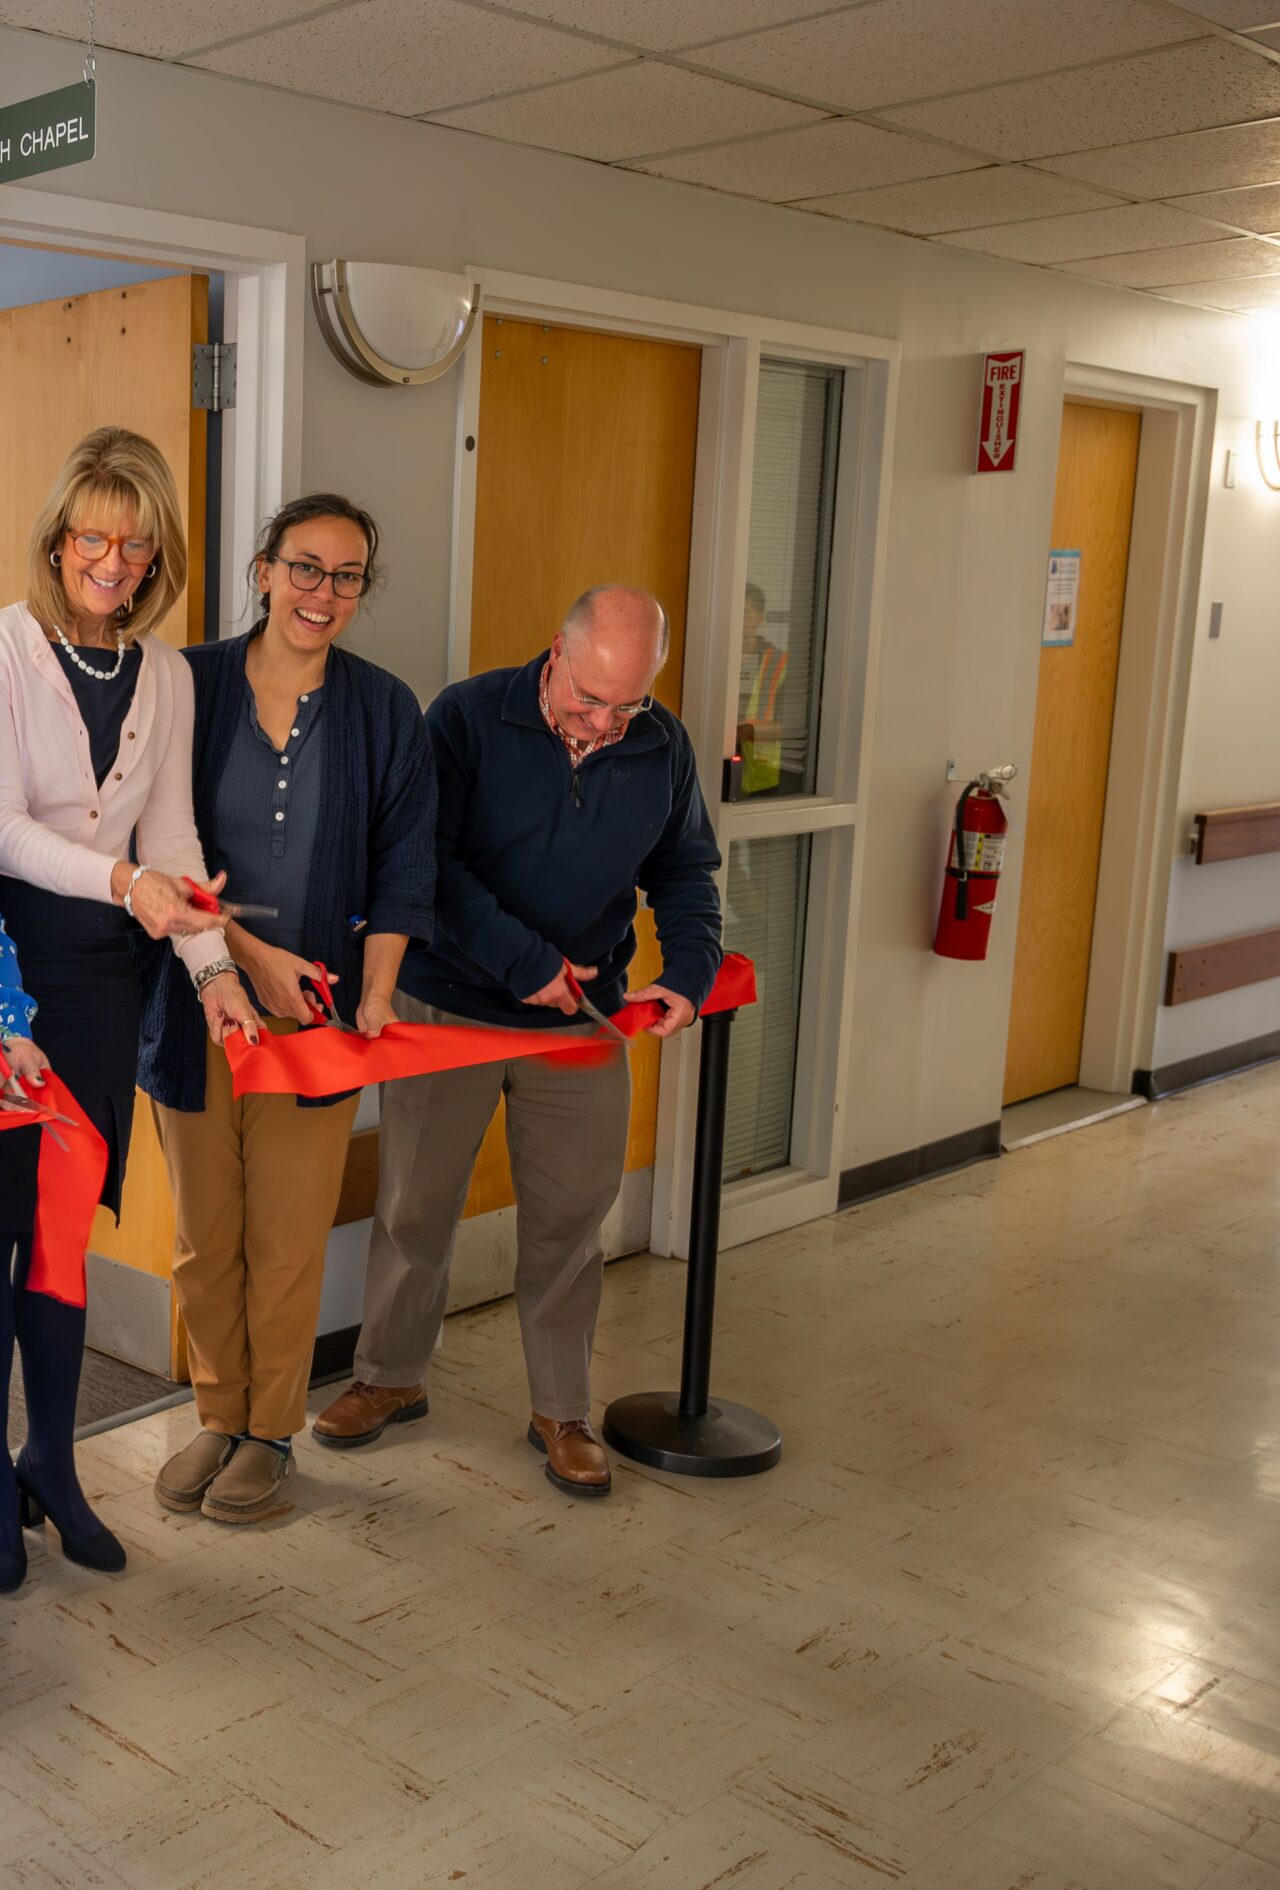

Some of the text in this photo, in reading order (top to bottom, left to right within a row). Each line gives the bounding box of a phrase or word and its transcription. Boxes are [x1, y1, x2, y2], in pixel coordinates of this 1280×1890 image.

[20, 116, 89, 157] CHAPEL
[990, 365, 1017, 381] FIRE
[993, 383, 1006, 459] EXTINGUISHER
